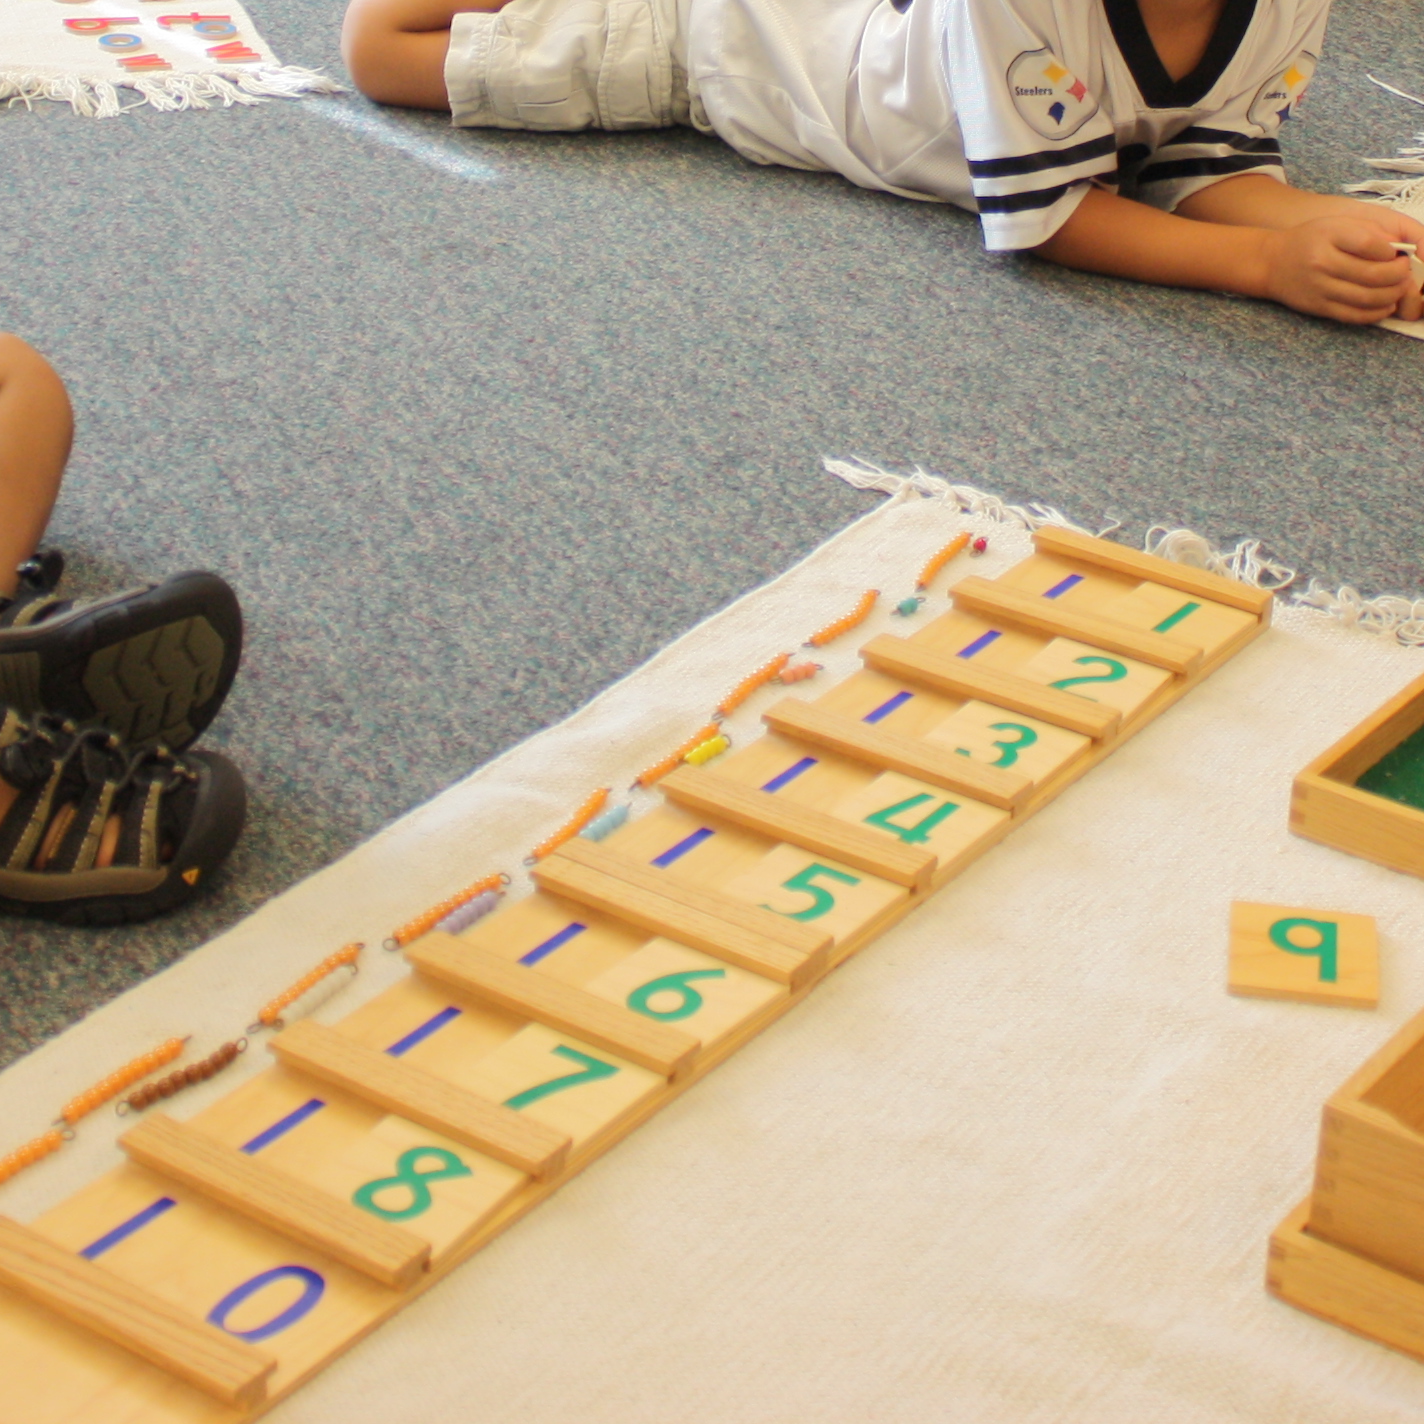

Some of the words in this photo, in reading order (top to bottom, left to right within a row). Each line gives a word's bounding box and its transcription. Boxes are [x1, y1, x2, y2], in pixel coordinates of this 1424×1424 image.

[63, 17, 173, 72] bow
[157, 12, 262, 63] tow
[1015, 86, 1053, 96] Steelers
[1268, 917, 1339, 983] 9
